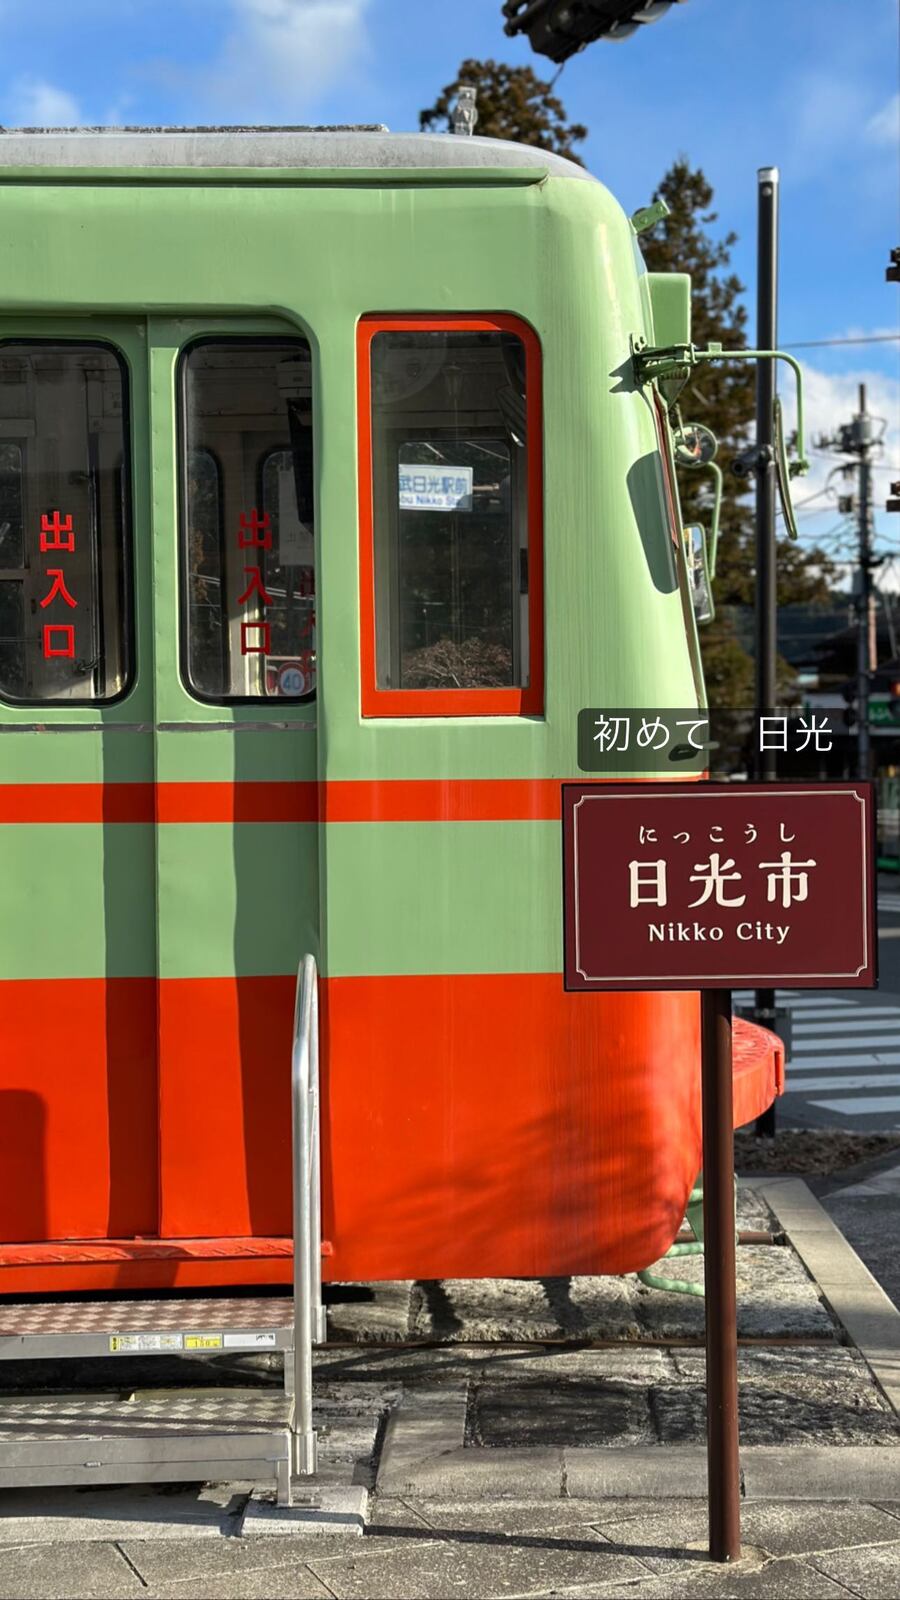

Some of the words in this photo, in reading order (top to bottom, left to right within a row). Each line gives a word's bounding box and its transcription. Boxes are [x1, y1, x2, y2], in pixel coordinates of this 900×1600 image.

[416, 496, 443, 506] Nikko
[39, 510, 77, 659] 出入口
[237, 508, 273, 656] 出入口
[283, 674, 301, 691] 40
[639, 822, 796, 844] にっこうし
[628, 851, 817, 908] 日光市
[648, 922, 724, 942] Nikko
[736, 921, 790, 944] City
